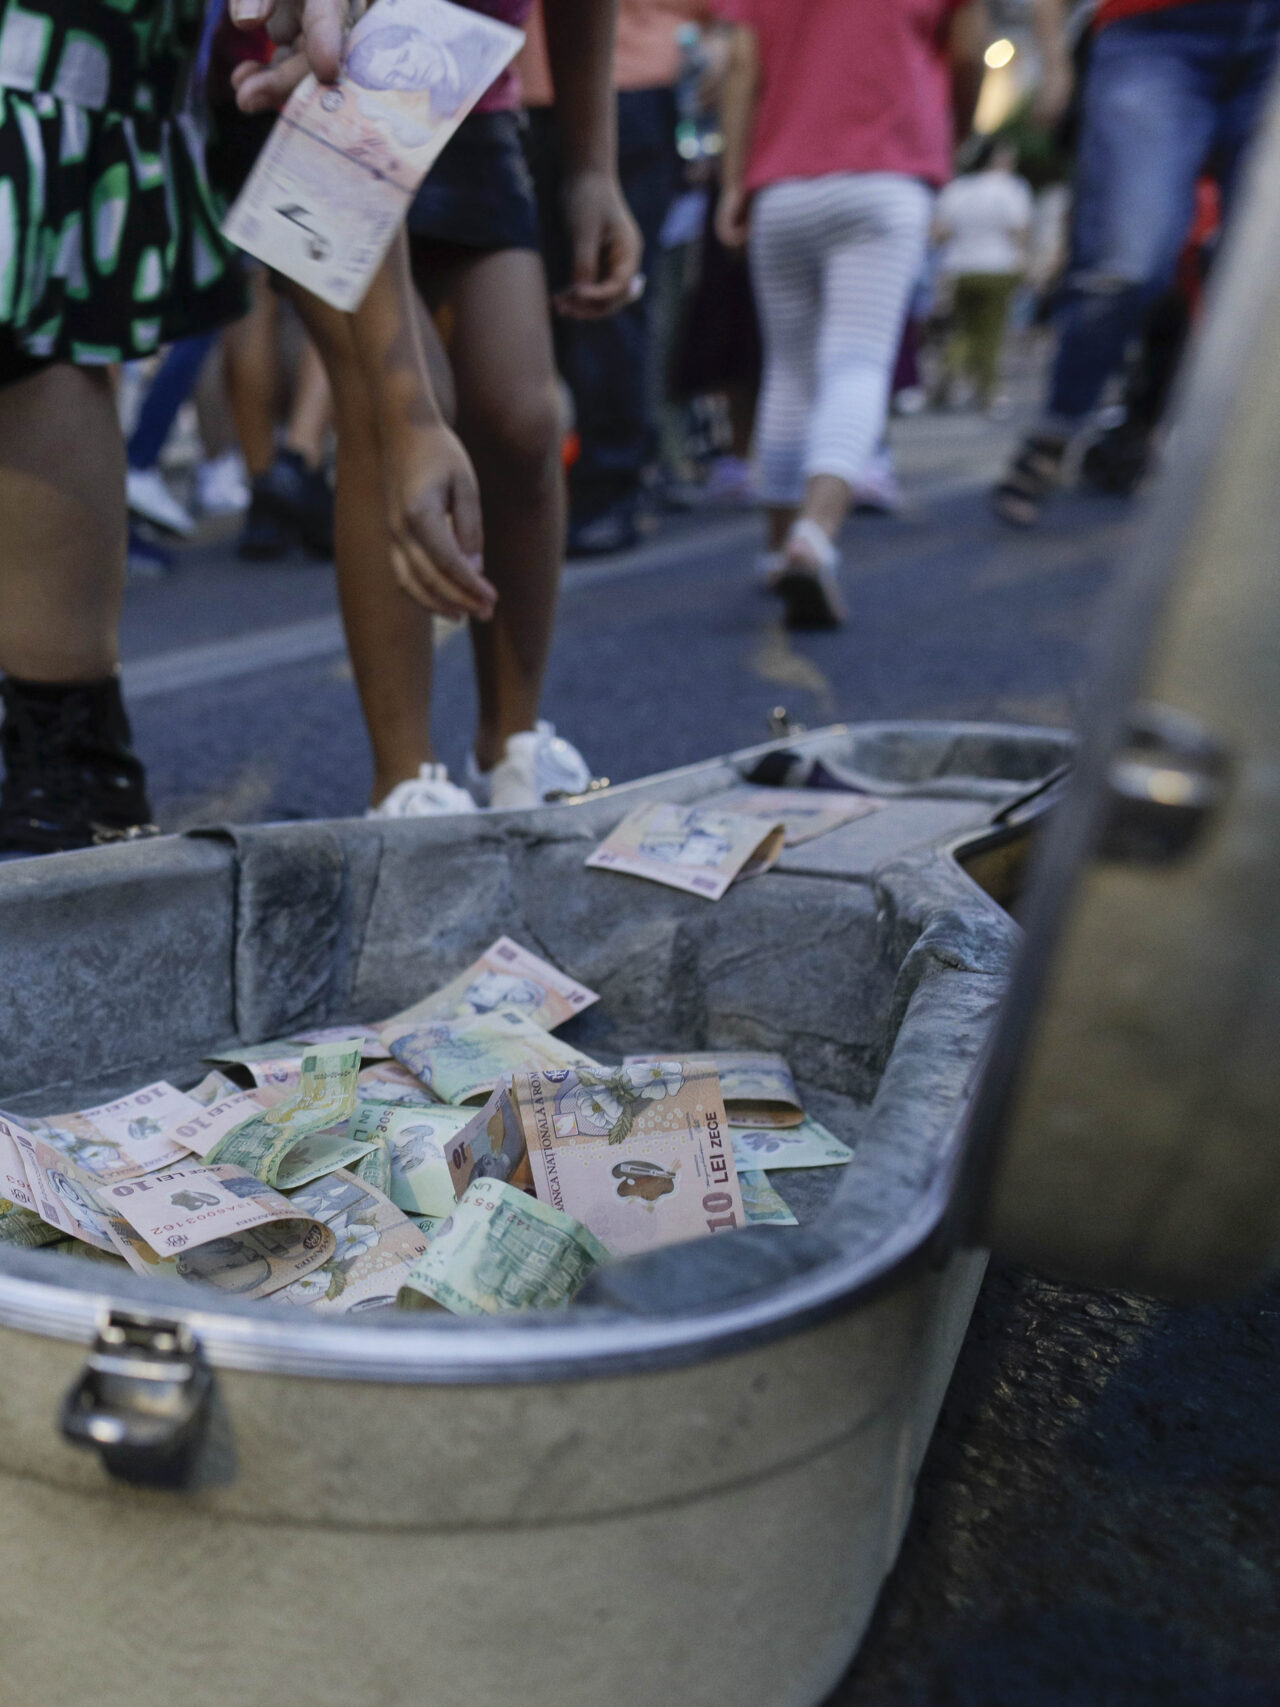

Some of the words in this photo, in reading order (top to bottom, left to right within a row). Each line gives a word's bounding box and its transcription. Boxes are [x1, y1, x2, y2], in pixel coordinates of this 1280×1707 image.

[134, 1087, 168, 1106] 10
[209, 1101, 233, 1118] LEI
[175, 1117, 212, 1139] 10
[705, 1111, 719, 1149] ZECE
[452, 1141, 468, 1170] 10
[156, 1172, 185, 1183] LEI
[710, 1154, 729, 1185] LEI
[112, 1181, 154, 1198] 10
[471, 1182, 492, 1193] UN
[702, 1191, 738, 1232] 10
